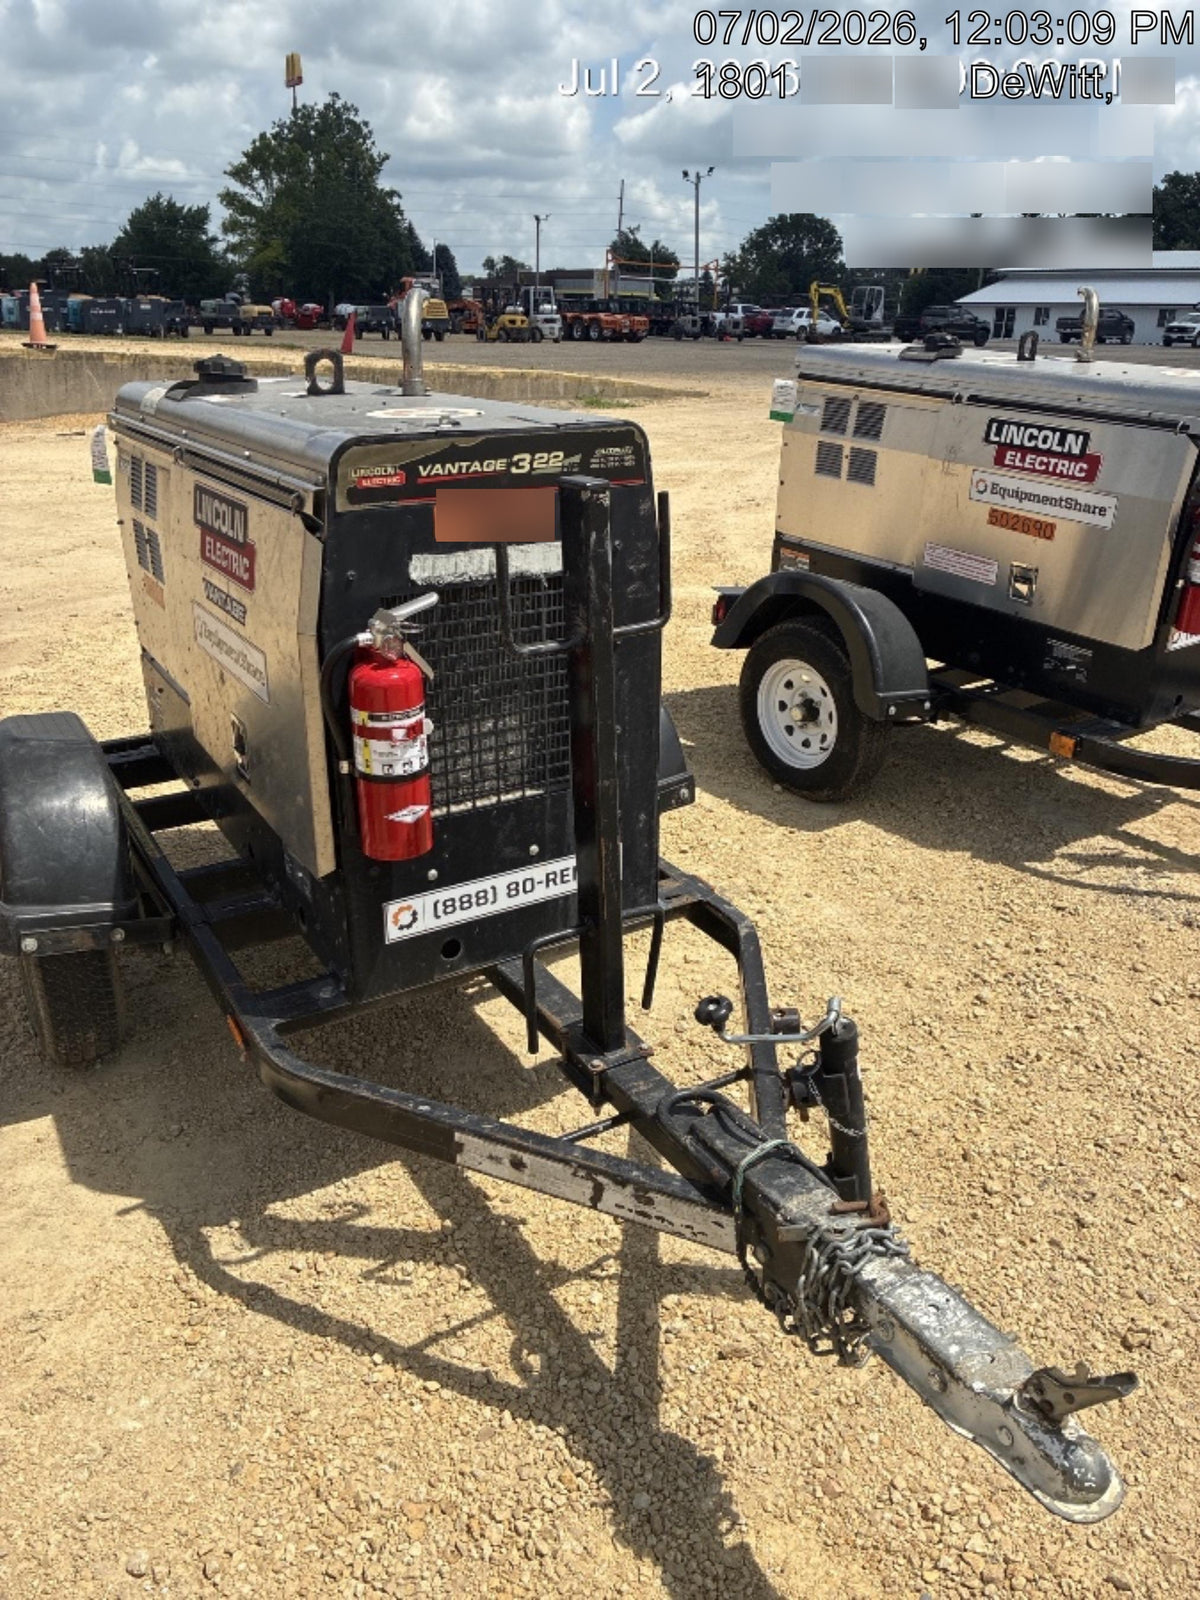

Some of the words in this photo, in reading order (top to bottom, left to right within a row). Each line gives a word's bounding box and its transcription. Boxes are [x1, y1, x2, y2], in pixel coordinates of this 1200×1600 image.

[989, 422, 1084, 454] LINCOLN
[351, 465, 399, 478] LINCOLN
[418, 459, 507, 477] VANTAGE
[510, 451, 564, 474] 322
[1004, 451, 1088, 477] ELECTRIC
[990, 482, 1107, 517] EquipmentShare
[196, 490, 244, 543] LINCOLN
[205, 536, 250, 580] ELECTRIC
[433, 885, 498, 919] (888)
